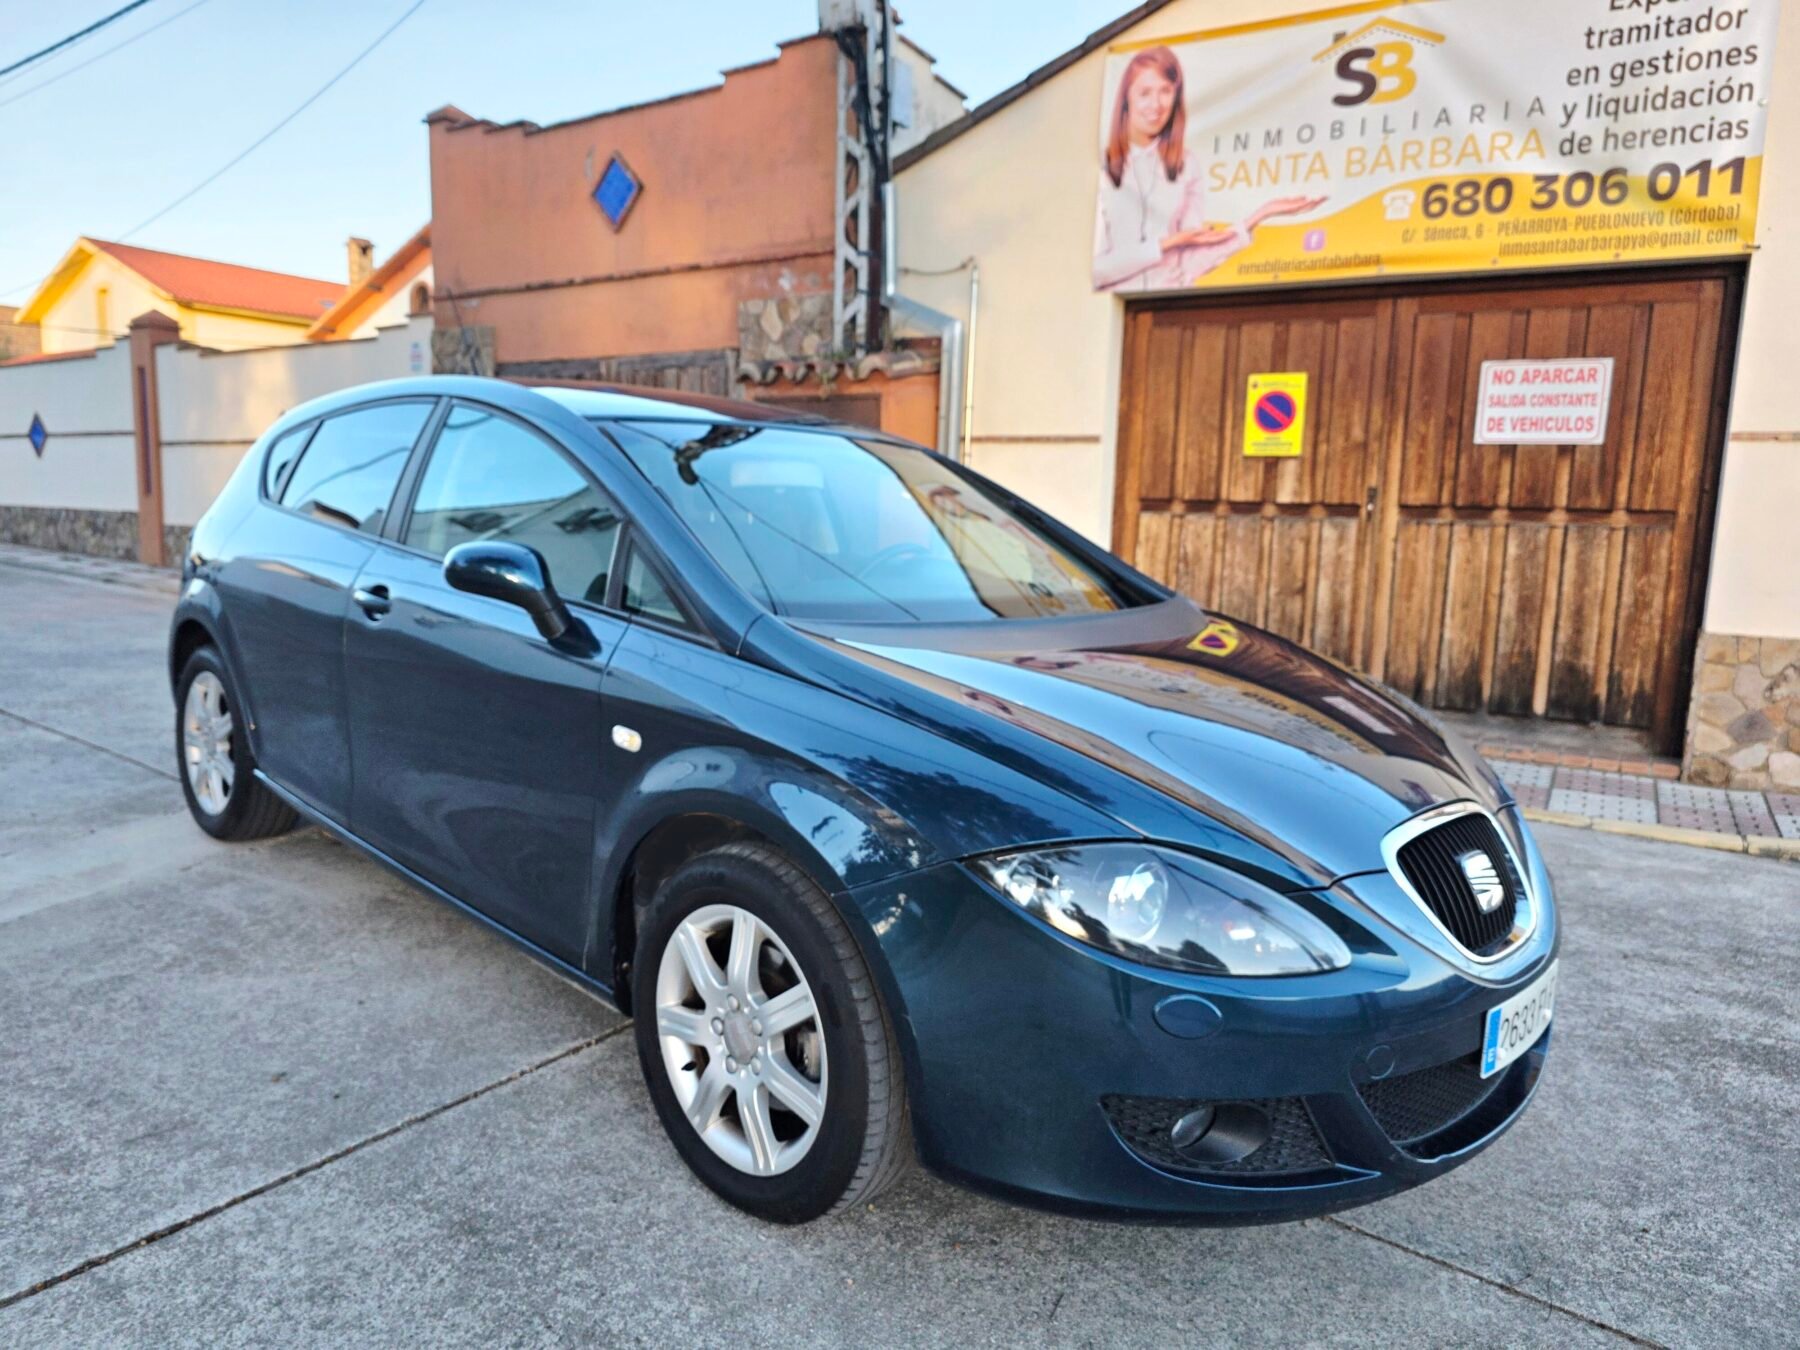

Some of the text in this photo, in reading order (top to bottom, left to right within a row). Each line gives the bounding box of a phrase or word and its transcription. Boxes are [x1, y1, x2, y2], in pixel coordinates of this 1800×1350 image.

[1584, 6, 1748, 50] tramitador
[1332, 41, 1417, 107] SB
[1566, 44, 1758, 87] en gestiones
[1559, 77, 1755, 128] y liquidación
[1213, 96, 1546, 154] INMOBILIARIA
[1559, 118, 1749, 157] de herencias
[1208, 128, 1546, 192] SANTA BÁRBARA
[1421, 156, 1746, 220] 680 306 011
[1669, 203, 1741, 227] (Córdoba)
[1492, 367, 1599, 385] NO APARCAR
[1487, 391, 1598, 408] SALIDA CONSTANTE
[1486, 416, 1595, 433] DE VEHICULOS
